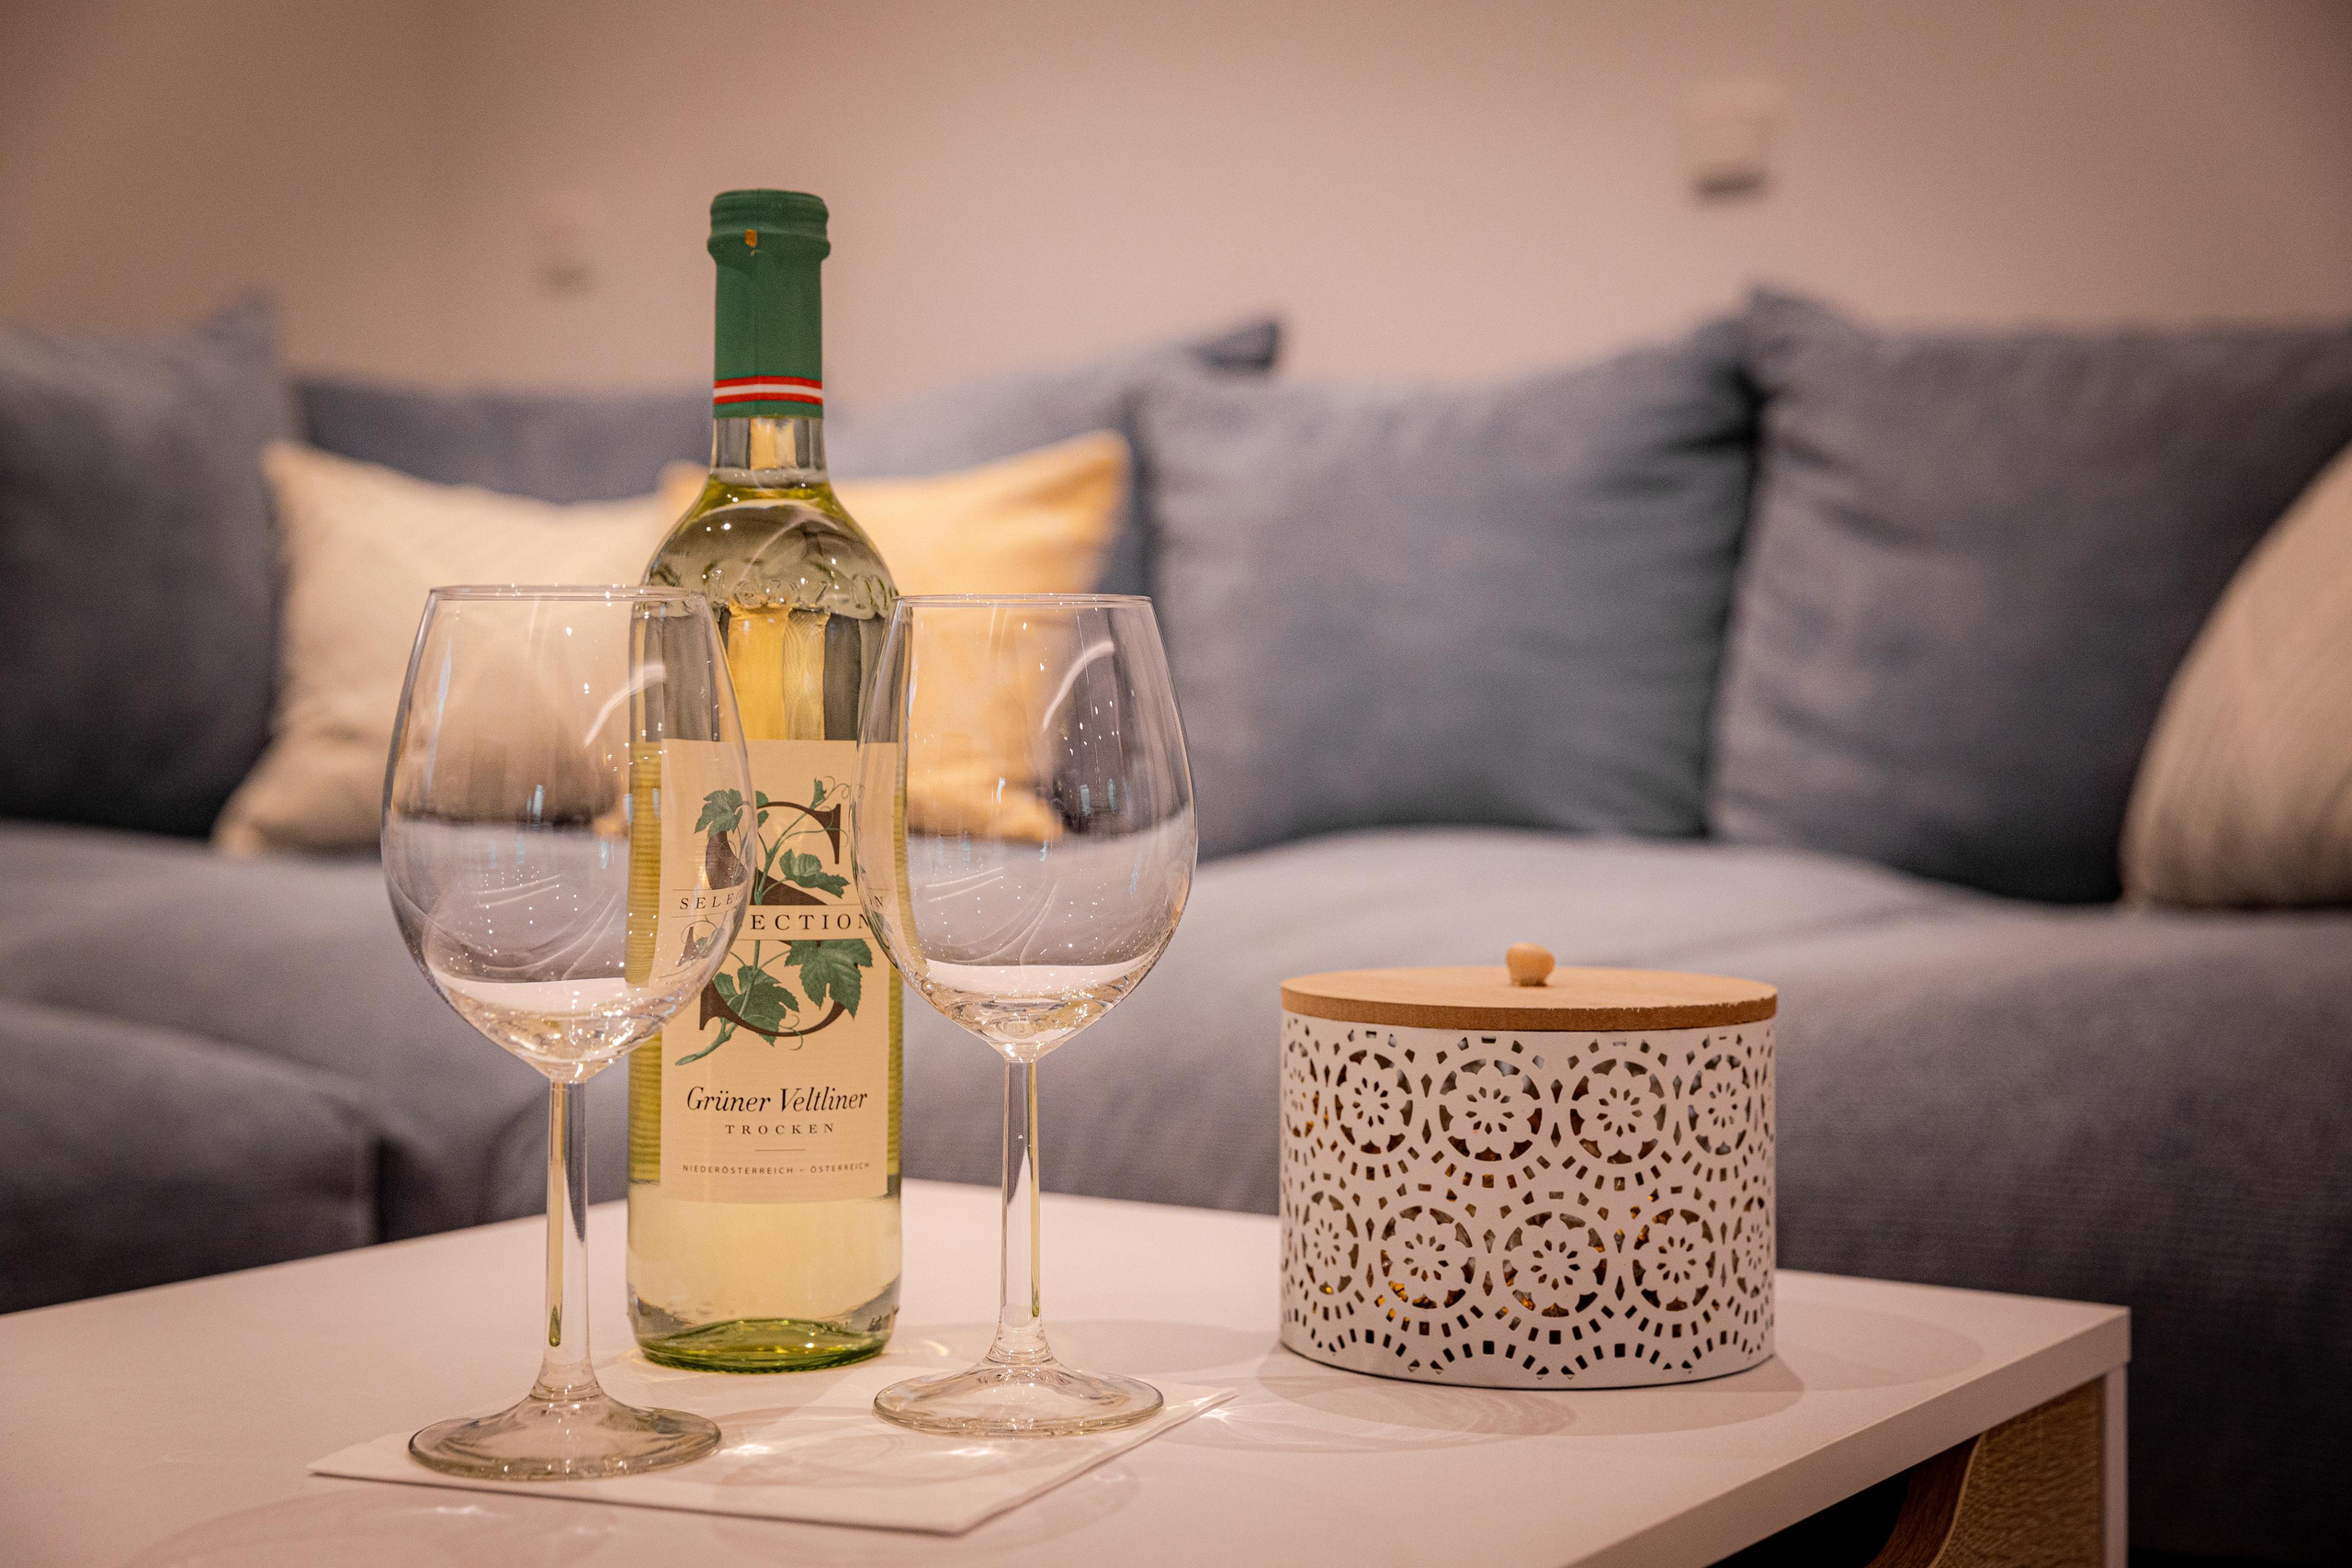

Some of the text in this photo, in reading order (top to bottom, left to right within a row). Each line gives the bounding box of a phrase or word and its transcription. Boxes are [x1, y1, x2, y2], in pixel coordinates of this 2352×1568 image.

[686, 1085, 868, 1112] Grüner Veltliner
[724, 1122, 834, 1136] TROCKEN
[682, 1163, 794, 1175] NIEDERÖSTERREICH
[809, 1161, 870, 1174] ÖSTERREICH
